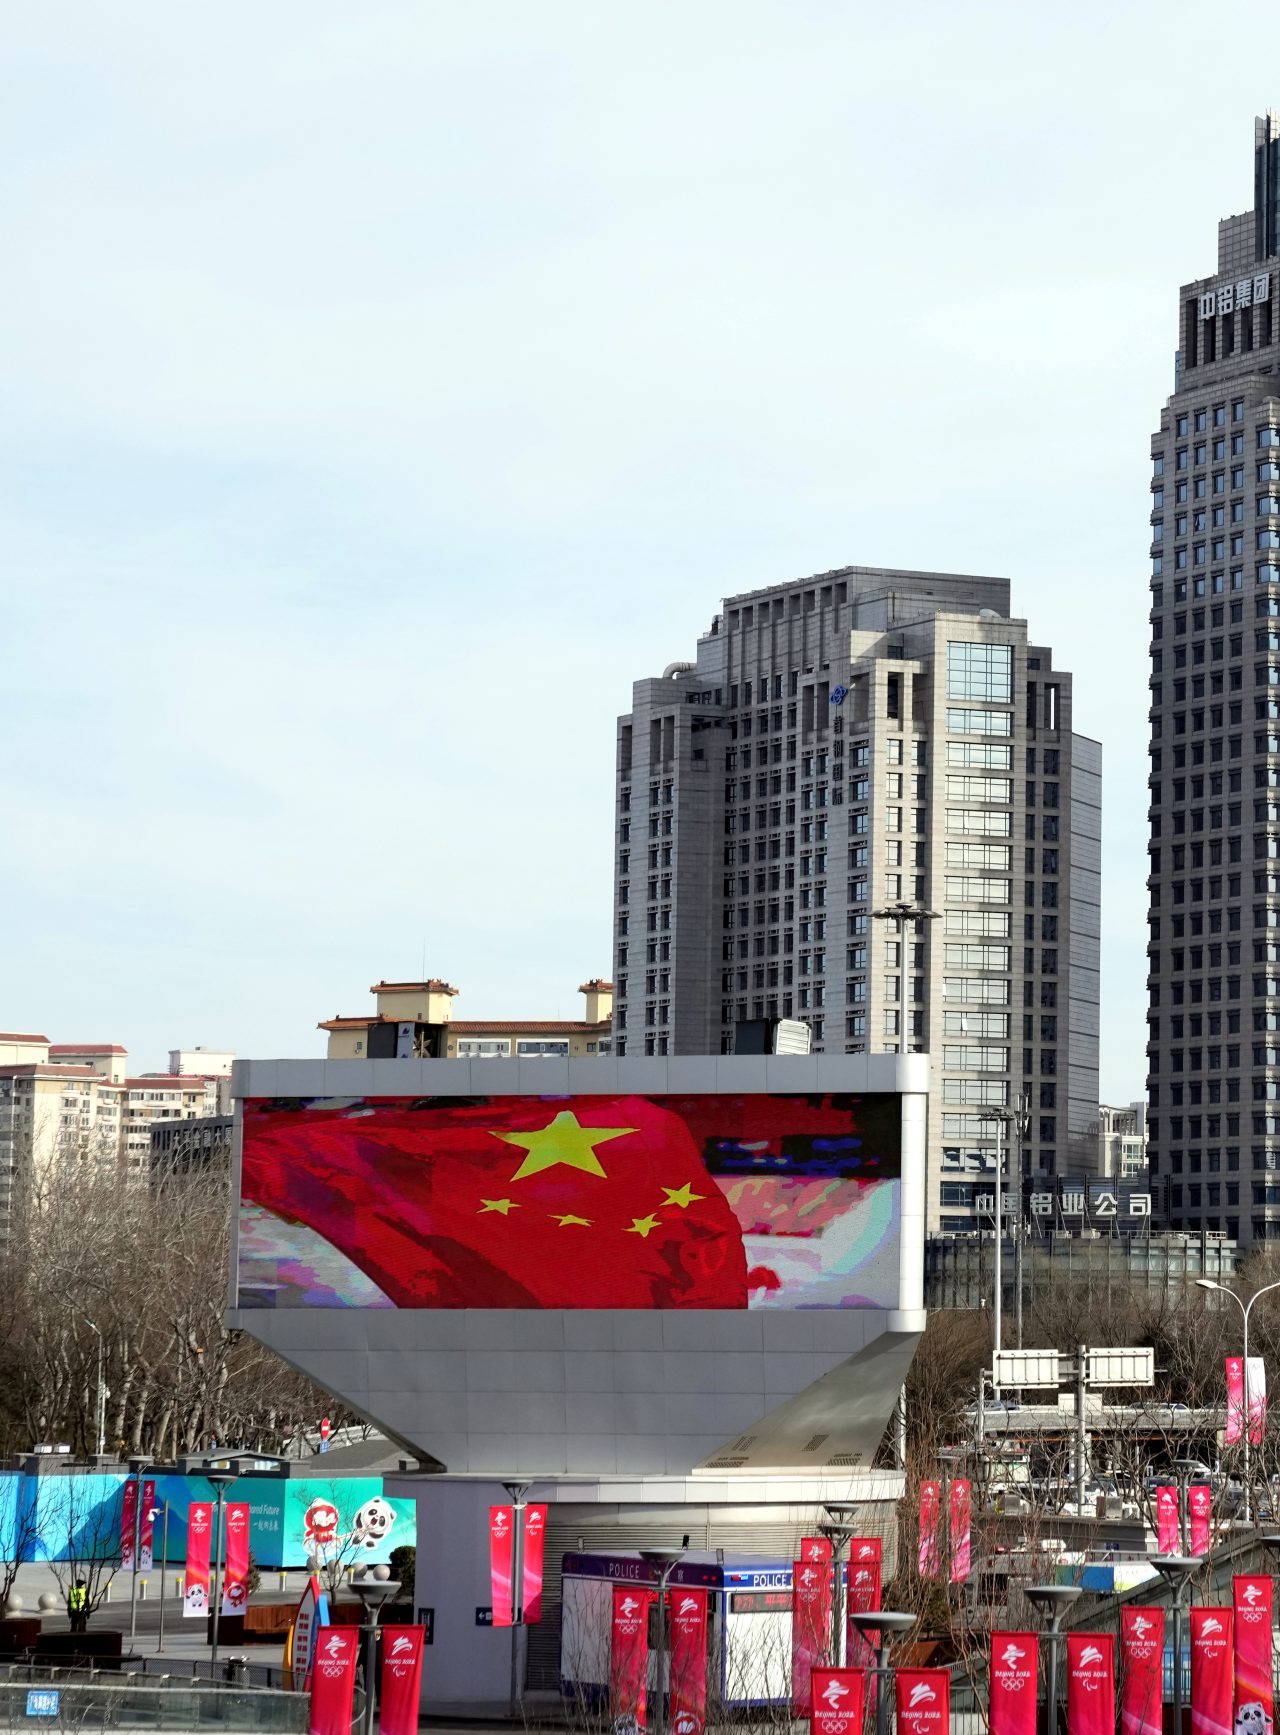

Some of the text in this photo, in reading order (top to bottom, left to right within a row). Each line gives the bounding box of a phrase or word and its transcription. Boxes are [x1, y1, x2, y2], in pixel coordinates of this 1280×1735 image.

[1200, 272, 1270, 320] 中铝集团
[975, 1192, 1152, 1216] 中国铝业公司
[608, 1562, 640, 1579] POLICE
[753, 1573, 787, 1588] POLICE
[995, 1670, 1015, 1678] BEIJING
[1072, 1670, 1091, 1678] BEIJING
[814, 1711, 855, 1719] BEIJING 2022
[901, 1711, 942, 1719] BEIJING 2022
